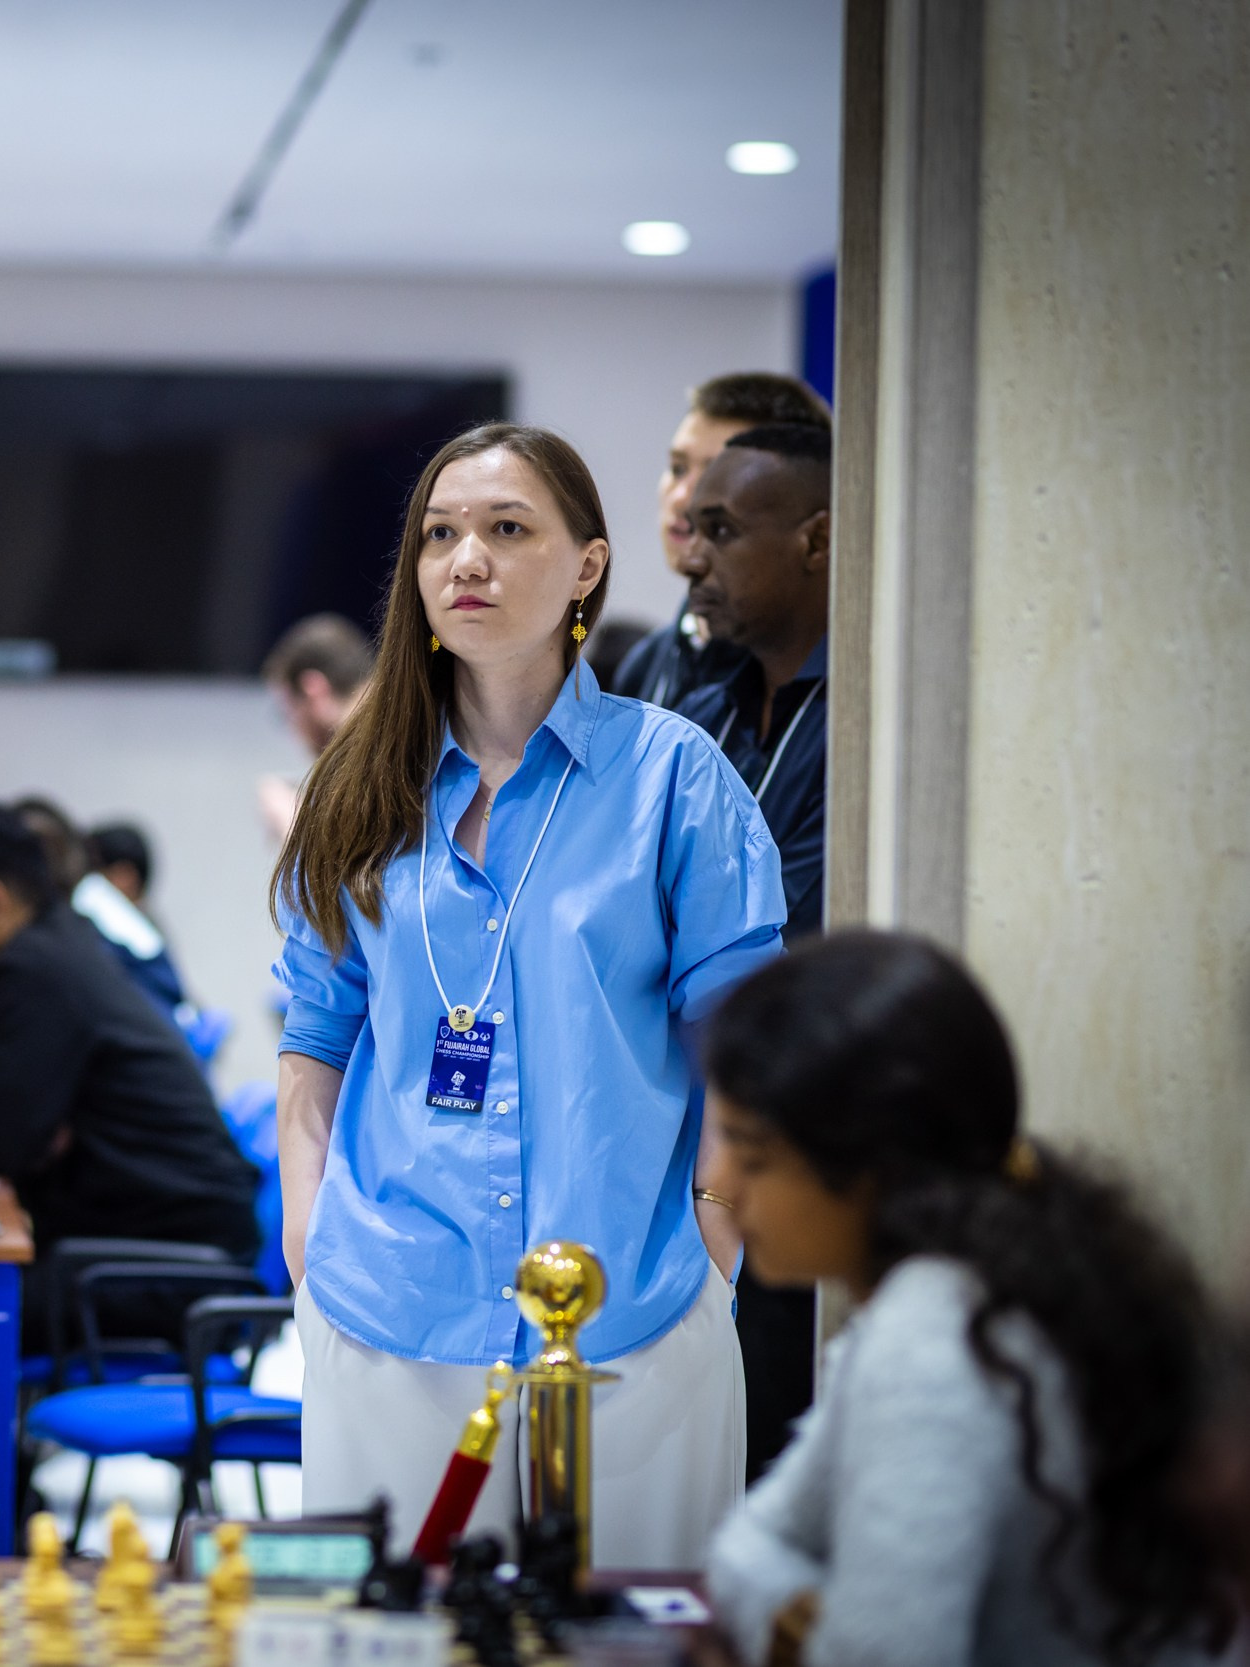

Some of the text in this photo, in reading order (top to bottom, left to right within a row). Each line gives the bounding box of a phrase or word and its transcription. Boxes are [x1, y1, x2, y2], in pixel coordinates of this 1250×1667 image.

[435, 1047, 452, 1055] CHESS
[452, 1050, 490, 1059] CHAMPIONSHIP
[470, 1044, 490, 1054] GLOBAL
[431, 1097, 477, 1110] FAIR PLAY
